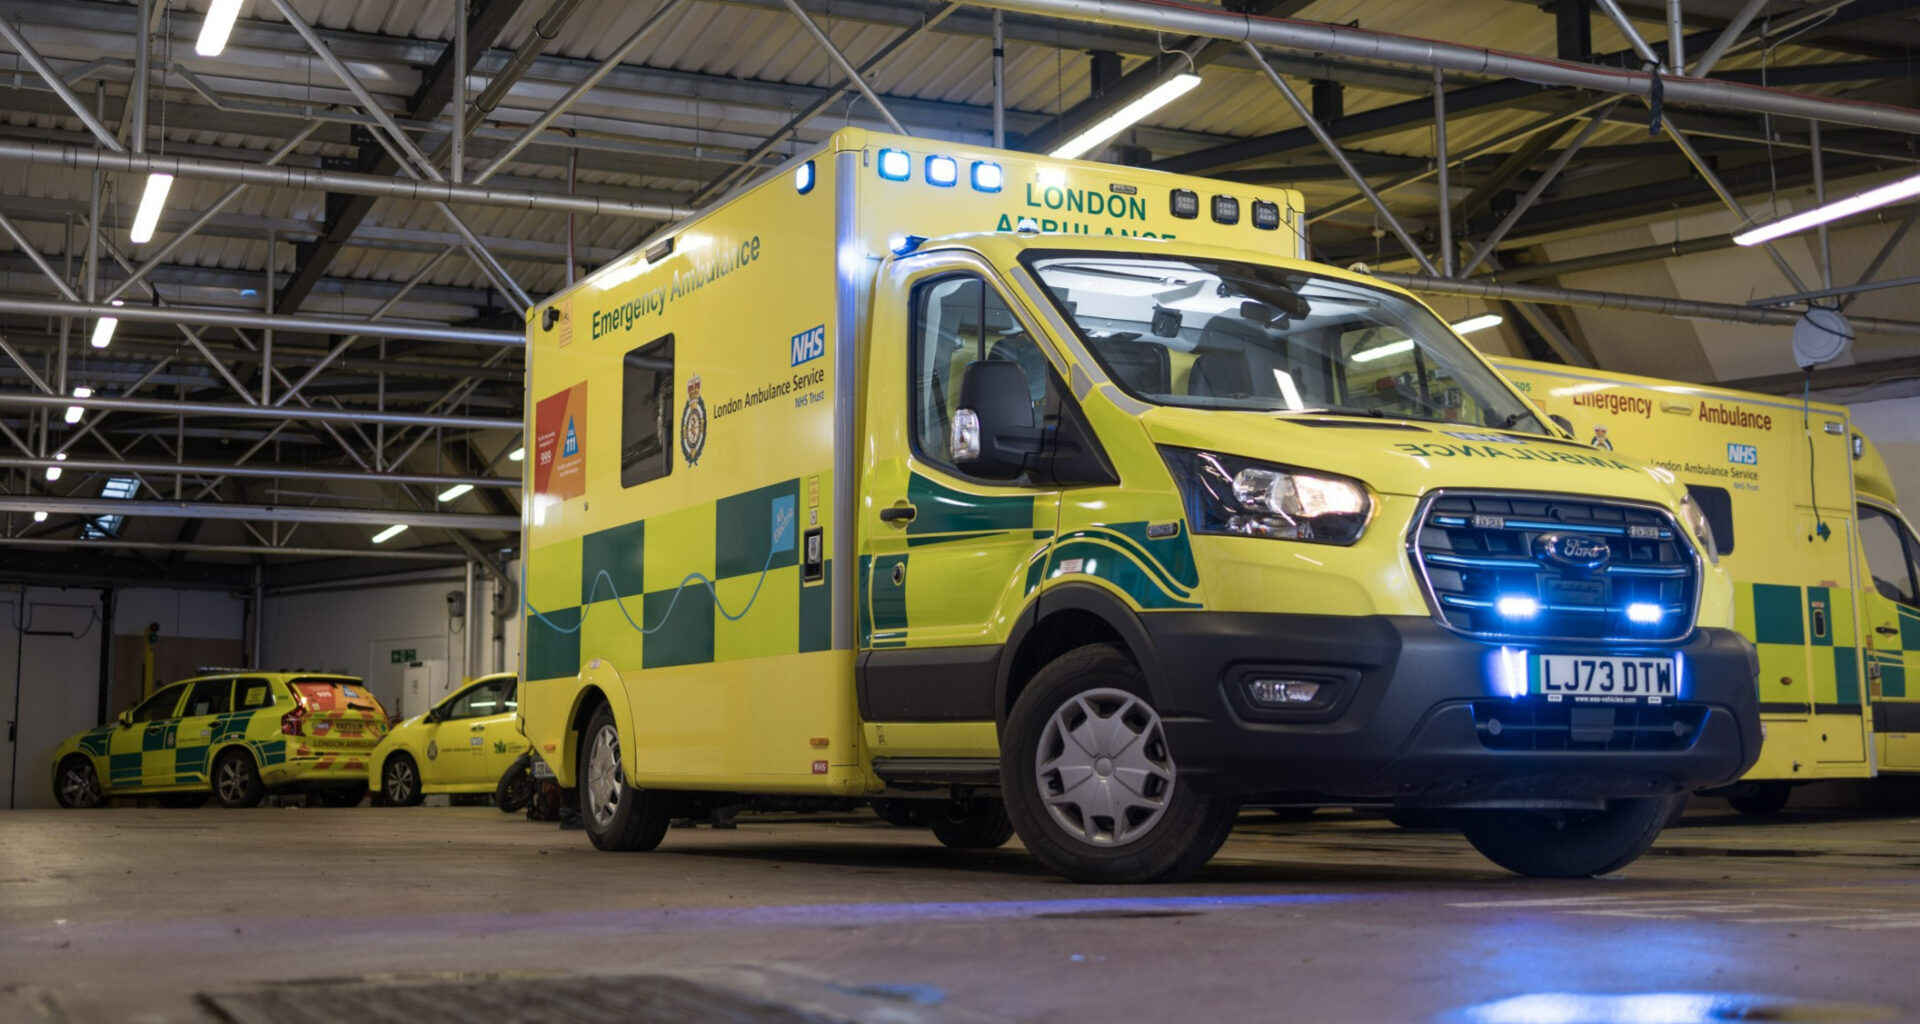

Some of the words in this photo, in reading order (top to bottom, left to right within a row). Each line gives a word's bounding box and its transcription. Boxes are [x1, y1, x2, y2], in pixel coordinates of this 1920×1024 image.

[1026, 183, 1146, 221] LONDON
[592, 283, 666, 340] Emergency
[670, 235, 761, 302] Ambulance
[791, 326, 825, 366] NHS
[713, 397, 742, 419] London
[744, 382, 791, 409] Ambulance
[793, 368, 825, 392] Service
[795, 395, 808, 408] NHS
[809, 390, 825, 403] Trust
[1572, 383, 1652, 419] Emergency
[1699, 400, 1772, 431] Ambulance
[540, 450, 552, 466] 999
[566, 437, 576, 452] 111
[1728, 444, 1756, 464] NHS
[1684, 462, 1729, 477] Ambulance
[1731, 467, 1759, 480] Service
[1563, 538, 1600, 558] Ford
[1544, 659, 1614, 692] LJ73
[1622, 661, 1671, 693] DTW
